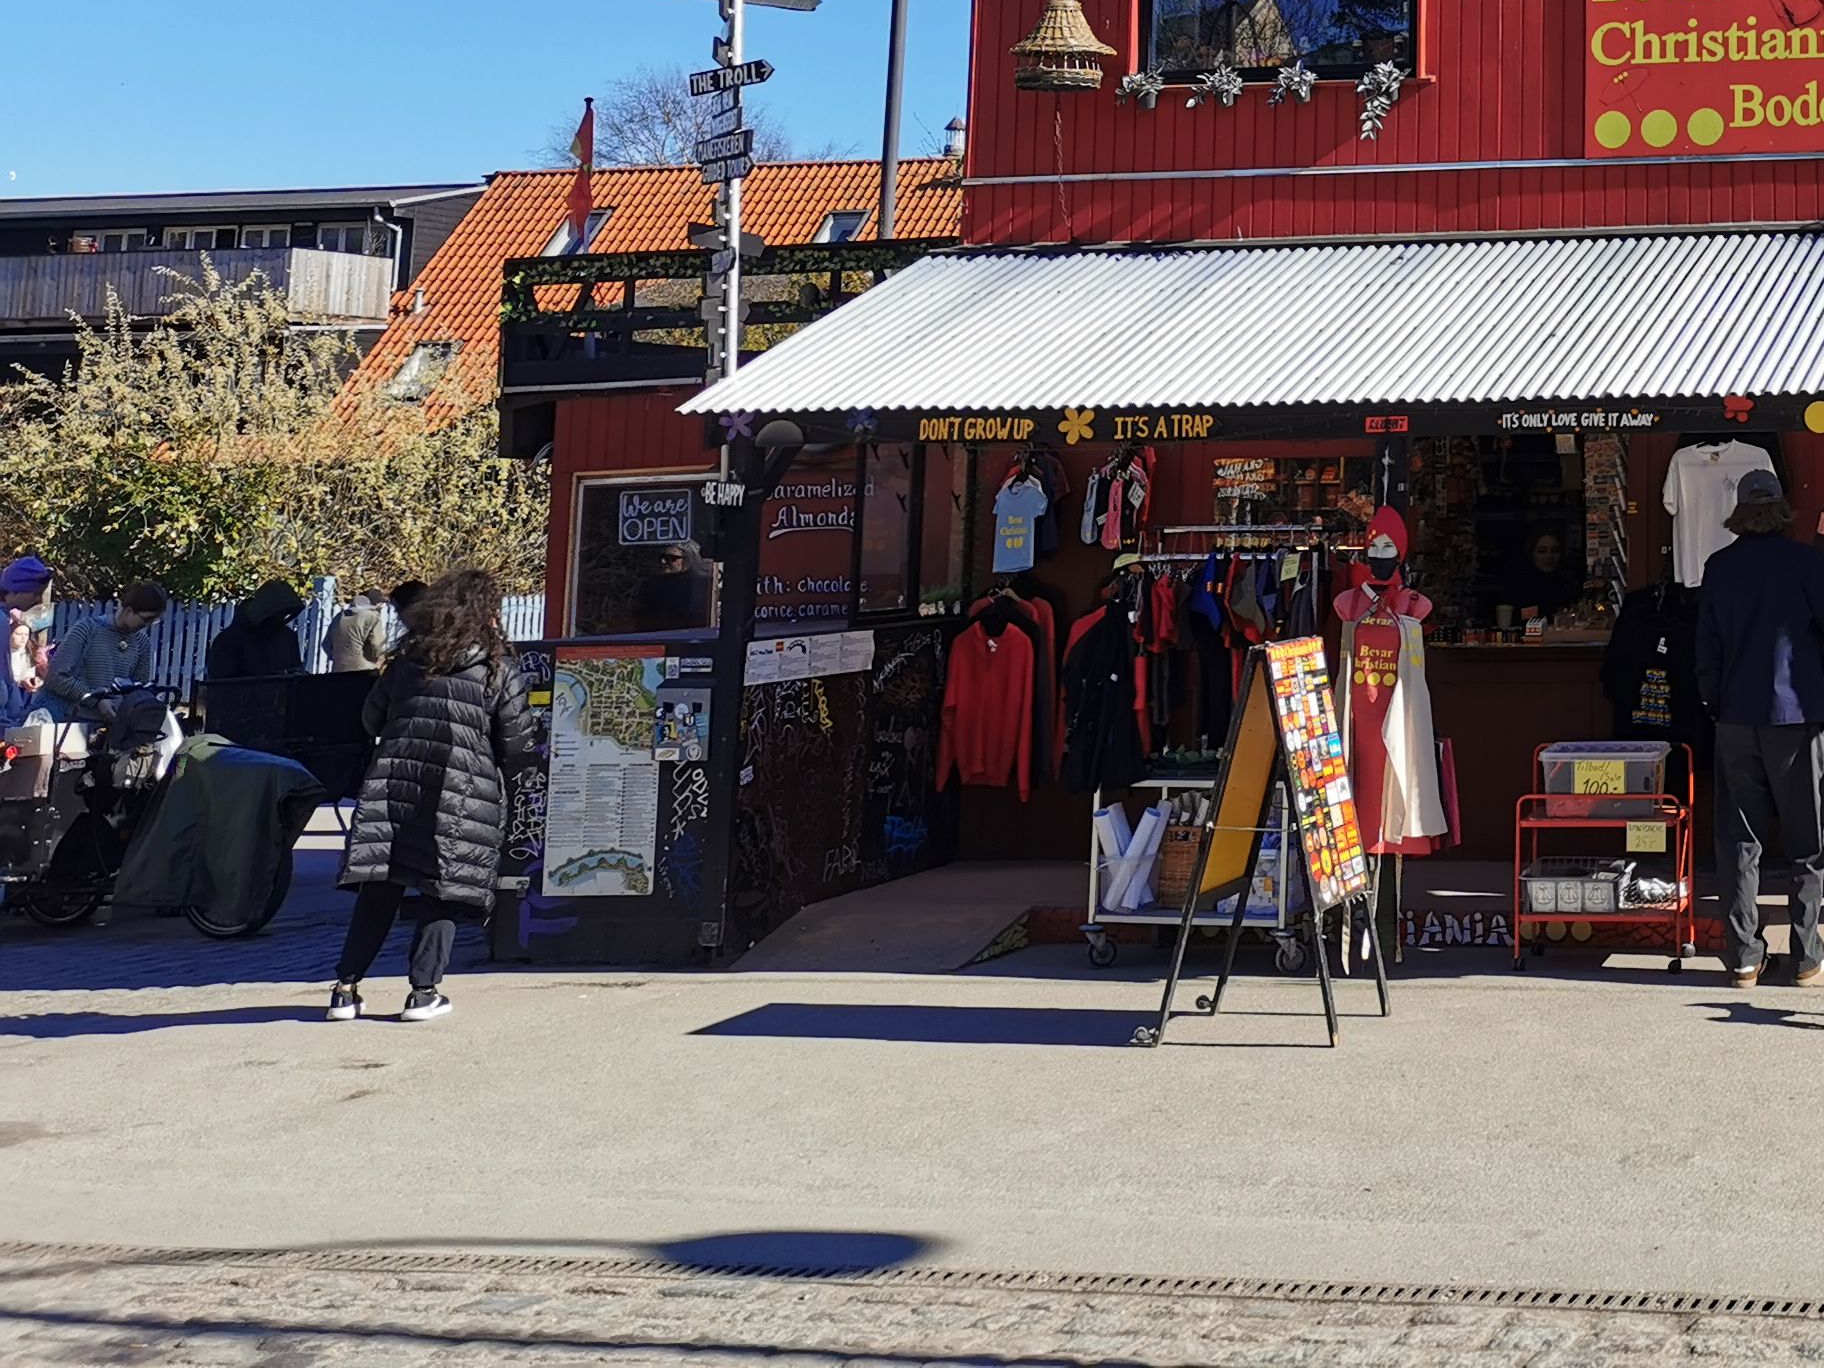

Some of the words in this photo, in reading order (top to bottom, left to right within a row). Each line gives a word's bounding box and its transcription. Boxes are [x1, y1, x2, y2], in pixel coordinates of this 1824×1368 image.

[690, 72, 715, 94] THE
[717, 63, 761, 89] TROLL
[919, 417, 962, 440] DON'T
[964, 417, 1012, 440] GROW
[1013, 417, 1035, 440] UP
[1114, 416, 1149, 439] IT'S
[1154, 415, 1168, 438] A
[1171, 414, 1213, 438] TRAP
[1502, 412, 1519, 429] IT'S
[1521, 413, 1549, 428] ONLY
[1552, 412, 1577, 427] LOVE
[1581, 412, 1605, 427] GIVE
[1608, 412, 1619, 427] IT
[1620, 412, 1653, 427] AWAY
[704, 482, 717, 504] BE
[717, 483, 746, 507] HAPPY
[622, 495, 651, 517] We
[654, 500, 687, 516] are
[623, 517, 688, 541] OPEN
[756, 575, 792, 595] ith:
[799, 602, 849, 617] carame
[1360, 645, 1393, 658] Bevar
